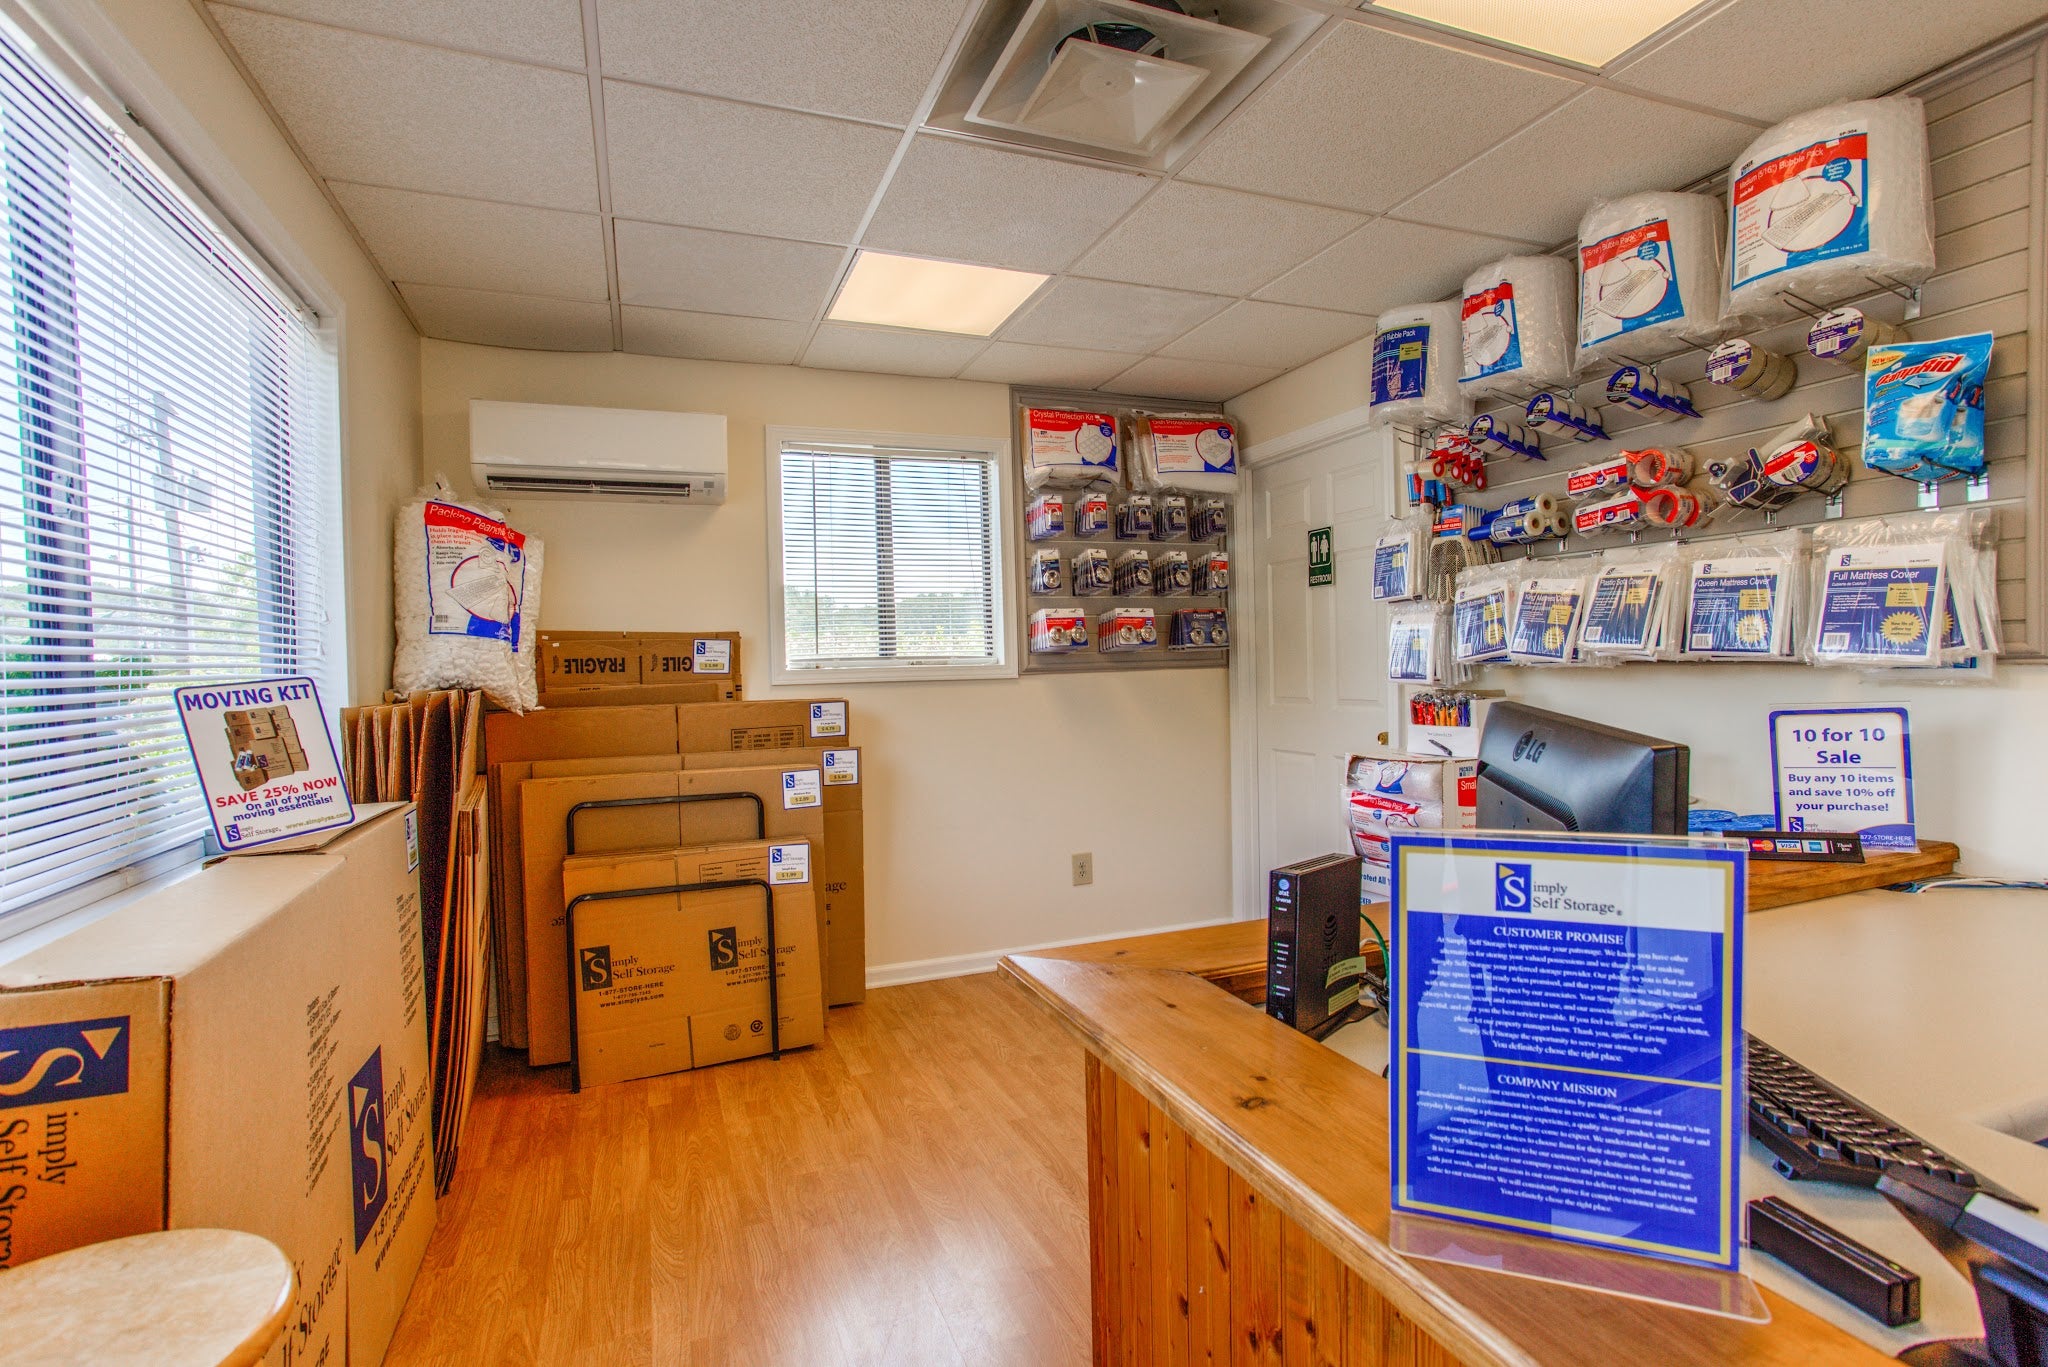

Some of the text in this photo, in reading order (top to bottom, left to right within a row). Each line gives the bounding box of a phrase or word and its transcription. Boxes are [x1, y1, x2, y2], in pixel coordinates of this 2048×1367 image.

[1740, 174, 1758, 188] Medium
[1778, 155, 1804, 170] Bubble
[1806, 148, 1824, 158] Pack
[1602, 240, 1618, 251] Bubble
[1620, 234, 1636, 245] Pack
[1387, 332, 1402, 341] Bubble
[1403, 329, 1416, 337] Pack
[1876, 354, 1966, 388] DampRid
[1034, 410, 1054, 419] Crystal
[1055, 412, 1085, 420] Protection
[430, 504, 471, 524] Packing
[1629, 578, 1644, 586] Cover
[1698, 578, 1771, 588] Queen Mattress Cover
[1833, 569, 1919, 581] Full Mattress Cover
[564, 657, 626, 675] FRAGILE
[662, 656, 692, 673] GILE
[183, 684, 310, 711] MOVING KIT
[1793, 728, 1886, 742] 10 for 10
[1525, 736, 1547, 764] LG
[1817, 750, 1862, 764] Sale
[1460, 780, 1476, 791] Smal
[1788, 774, 1894, 784] Buy any 10 items
[216, 776, 338, 808] SAVE 25% NOW
[1788, 788, 1896, 797] and save 10% off
[233, 796, 334, 822] moving essentials!
[246, 792, 318, 812] On all of your
[1796, 803, 1889, 812] your purchase!
[286, 812, 350, 830] www.simplyss.com
[241, 828, 256, 839] Self
[1362, 874, 1386, 884] rotect All
[1533, 896, 1615, 916] Self Storage
[1494, 926, 1624, 945] CUSTOMER PROMISE
[738, 948, 758, 960] Self
[1444, 937, 1468, 946] Simply
[1483, 939, 1506, 949] Storage
[1519, 943, 1552, 952] appreciate
[1568, 946, 1603, 956] patronage.
[1604, 949, 1616, 957] We
[1617, 950, 1636, 958] know
[1652, 953, 1669, 961] have
[1670, 954, 1688, 962] other
[613, 963, 676, 980] Self Storage
[725, 961, 786, 976] 1-877-STORE-RE
[598, 981, 664, 996] 1-877-STORE-HERE
[600, 993, 665, 1008] www.simplyss.com
[1458, 1026, 1480, 1036] Simply
[1482, 1028, 1495, 1036] Self
[1496, 1030, 1520, 1040] Storage
[1532, 1034, 1569, 1045] opportunity
[1614, 1044, 1639, 1053] storage
[1640, 1046, 1662, 1054] needs.
[1492, 1040, 1624, 1062] You definitely chose the right place.
[1498, 1074, 1617, 1098] COMPANY MISSION
[386, 1076, 428, 1168] Self Storage
[372, 1131, 426, 1247] 1-877-STORE-HERE
[1500, 1187, 1613, 1212] You definitely chose the right place.
[374, 1159, 426, 1274] www.simplyss.com
[297, 1237, 344, 1358] Storage
